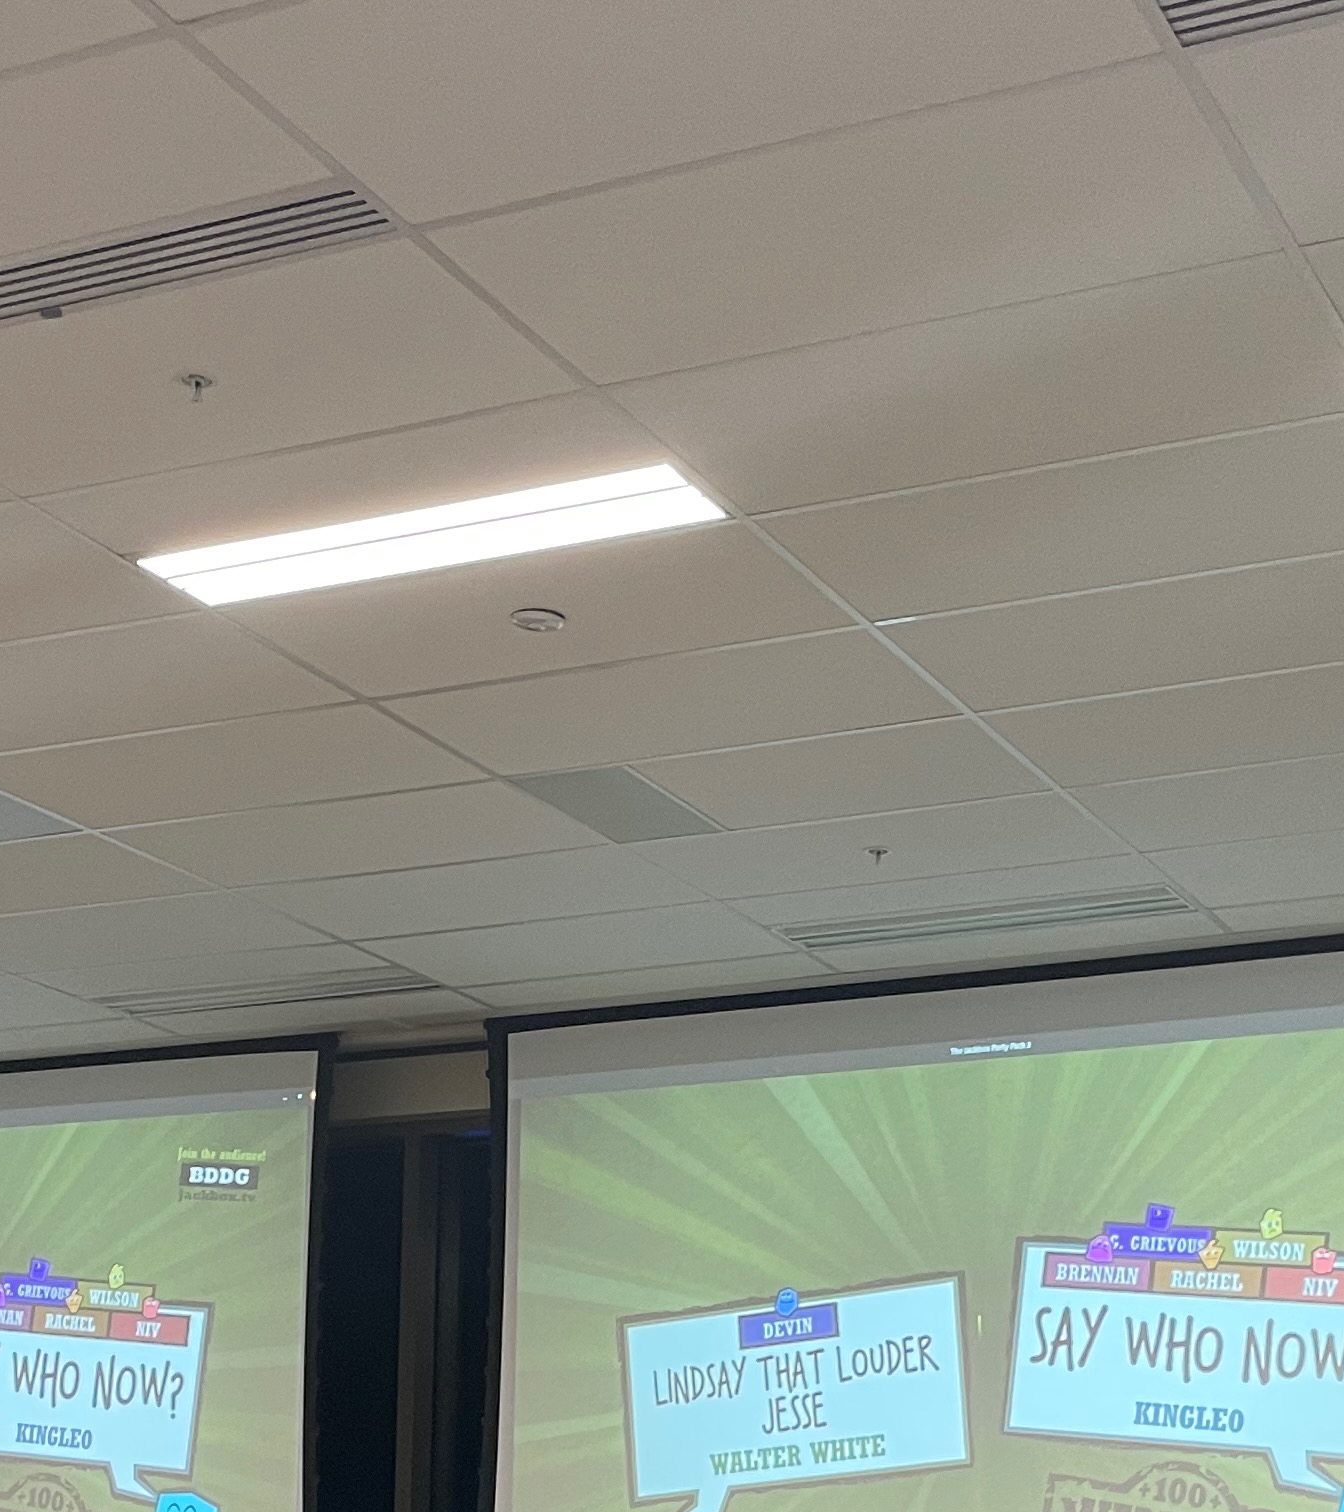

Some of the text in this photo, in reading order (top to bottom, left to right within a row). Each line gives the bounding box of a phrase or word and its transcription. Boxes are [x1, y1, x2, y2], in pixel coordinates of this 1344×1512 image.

[201, 1147, 216, 1160] the
[189, 1166, 250, 1185] BDDG
[1130, 1235, 1206, 1254] GRIEVOUS
[1233, 1239, 1305, 1262] WILSON
[1056, 1262, 1140, 1286] BRENNAN
[1170, 1270, 1244, 1292] RACHEL
[17, 1283, 71, 1300] GRIEVOUS
[89, 1289, 140, 1307] WILSON
[1302, 1277, 1339, 1298] NIV
[44, 1313, 97, 1333] RACHEL
[135, 1321, 162, 1338] NIV
[763, 1317, 813, 1340] DEVIN
[1029, 1304, 1109, 1371] SAY
[1125, 1312, 1224, 1383] WHO
[653, 1335, 940, 1406] LINDSAY THAT LOUDER
[12, 1348, 80, 1408] WHO
[92, 1354, 184, 1419] NOW?
[761, 1391, 827, 1434] JESSE
[1133, 1401, 1244, 1433] KINGLEO
[15, 1422, 93, 1450] KINGLEO
[709, 1434, 886, 1475] WALTER WHITE
